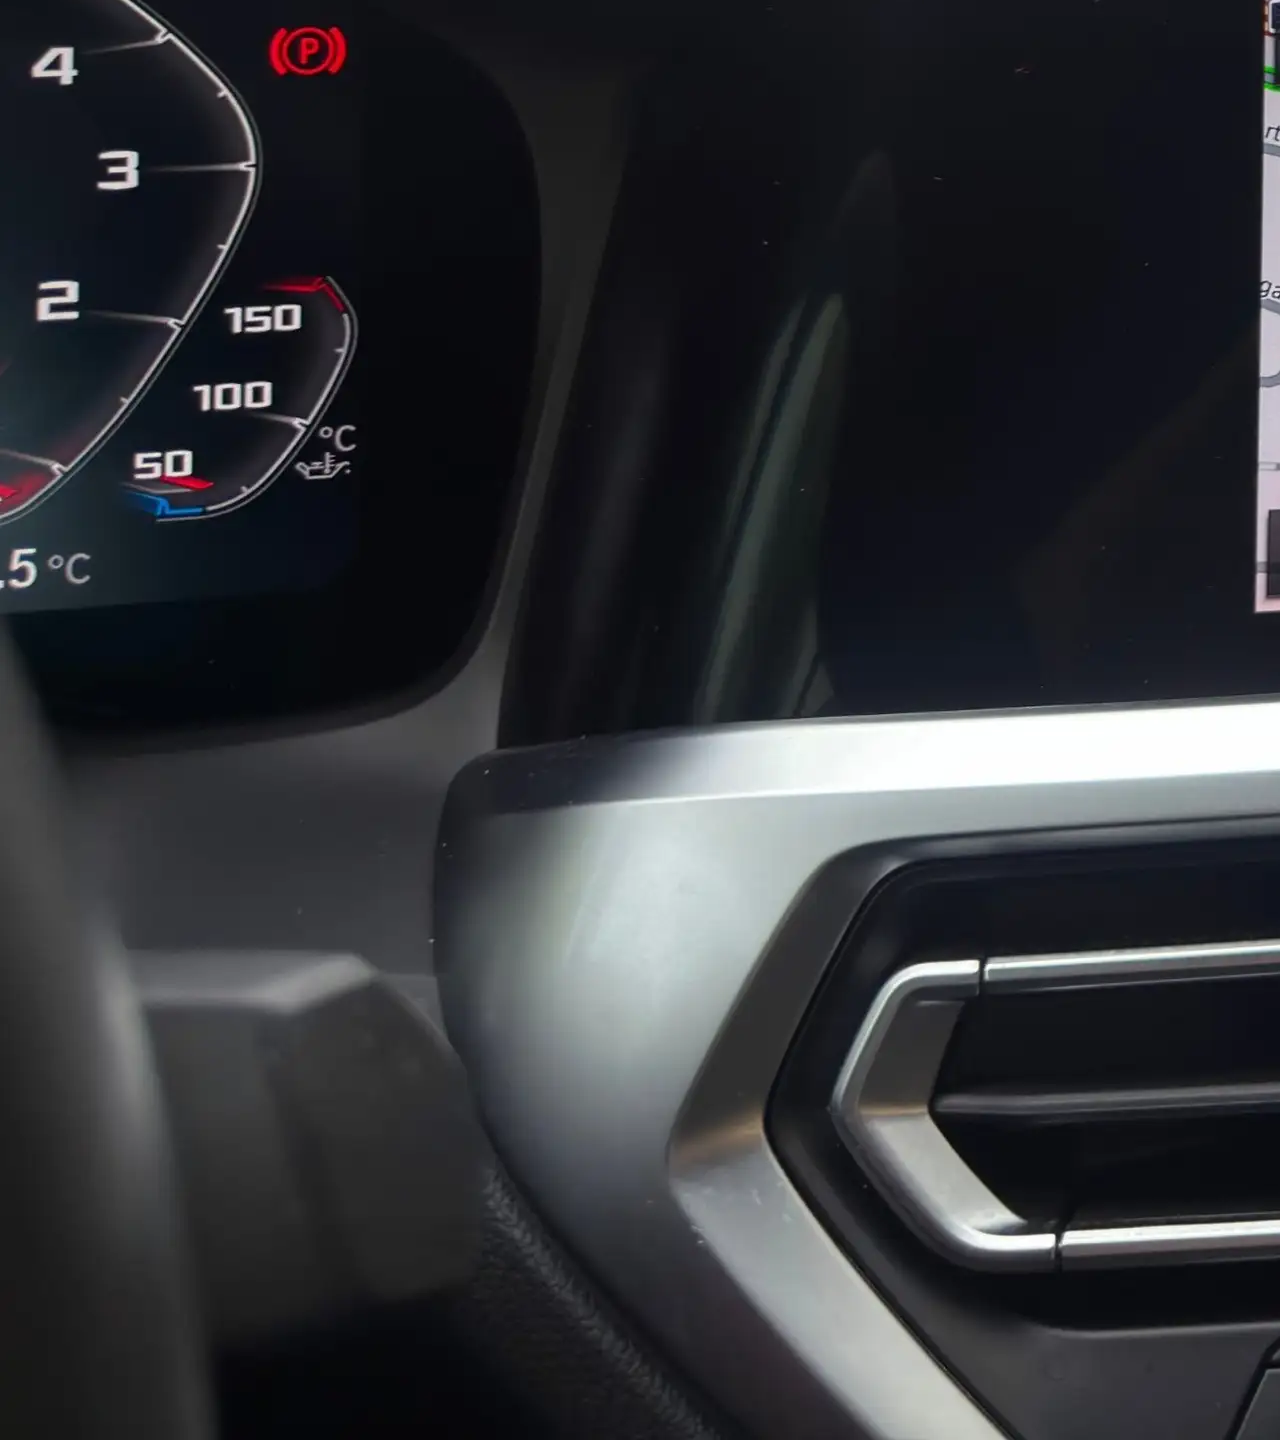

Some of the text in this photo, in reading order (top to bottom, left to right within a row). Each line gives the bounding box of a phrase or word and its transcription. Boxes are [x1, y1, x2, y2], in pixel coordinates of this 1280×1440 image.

[30, 46, 79, 85] 4
[96, 150, 140, 190] 3
[36, 280, 80, 322] 2
[224, 304, 302, 334] 150
[192, 380, 273, 411] 100
[133, 449, 194, 479] 50
